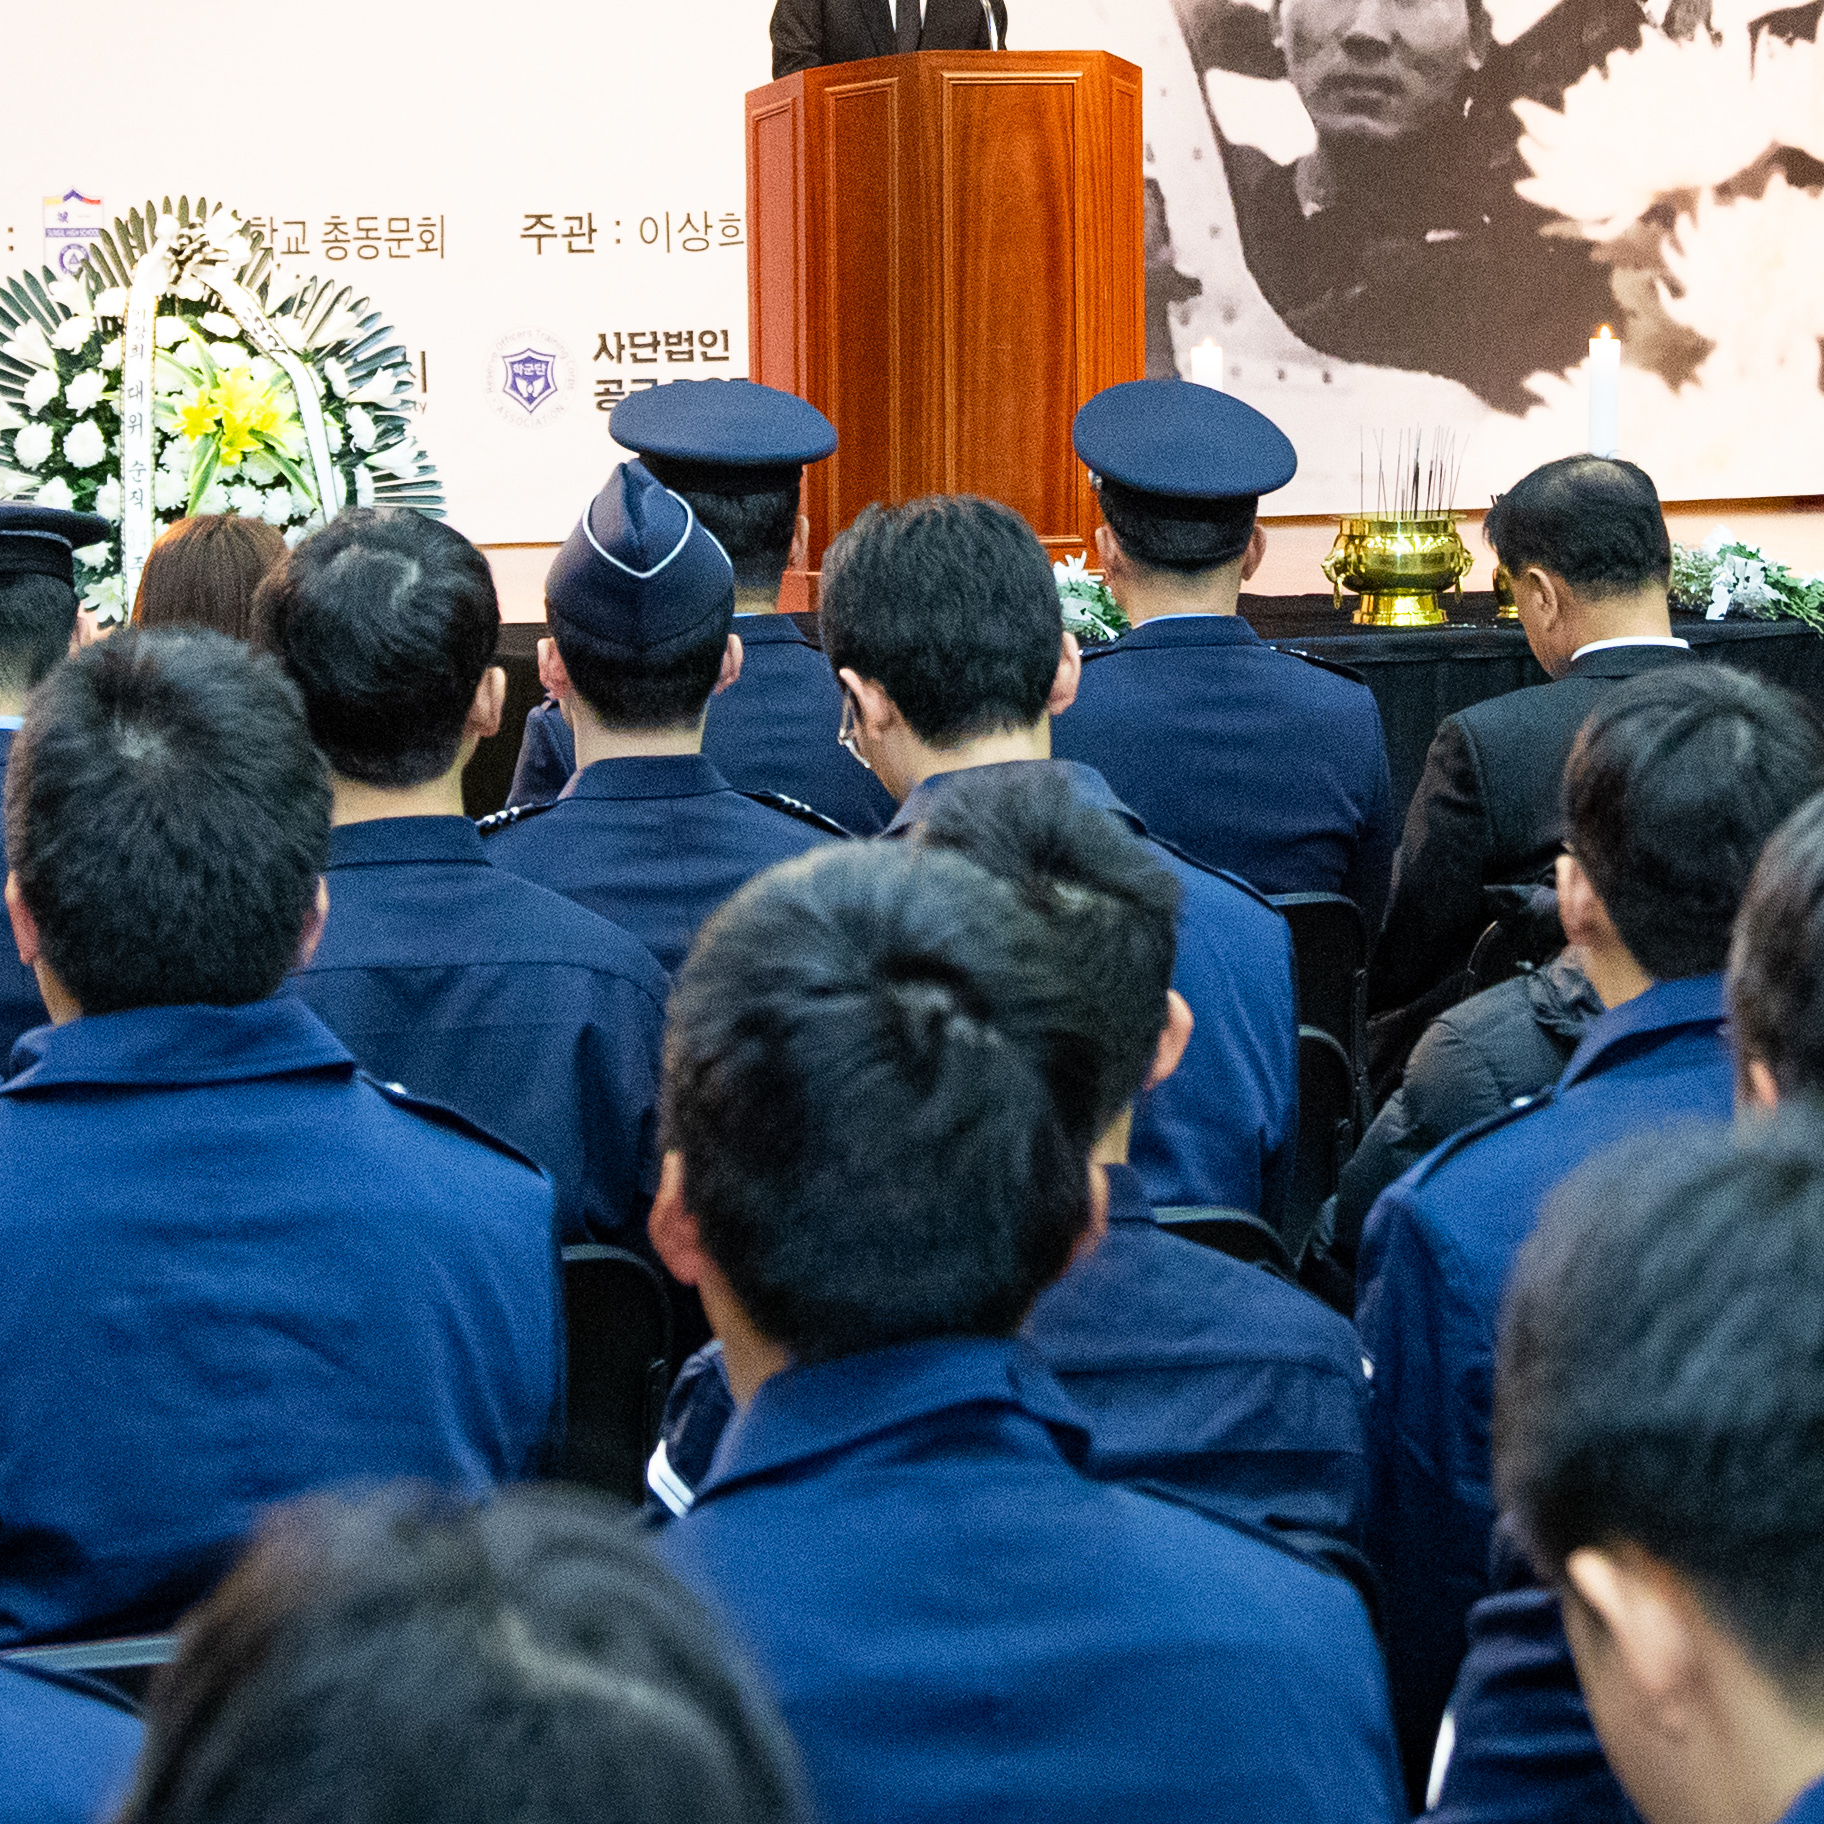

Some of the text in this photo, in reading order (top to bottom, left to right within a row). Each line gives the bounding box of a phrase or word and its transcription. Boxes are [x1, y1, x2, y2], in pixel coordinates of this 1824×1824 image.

[321, 214, 445, 262] 총동문회
[519, 212, 598, 256] 주관
[513, 362, 547, 377] 학군단
[592, 329, 731, 365] 사단법인
[127, 379, 144, 439] 대위
[128, 459, 148, 511] 순직
